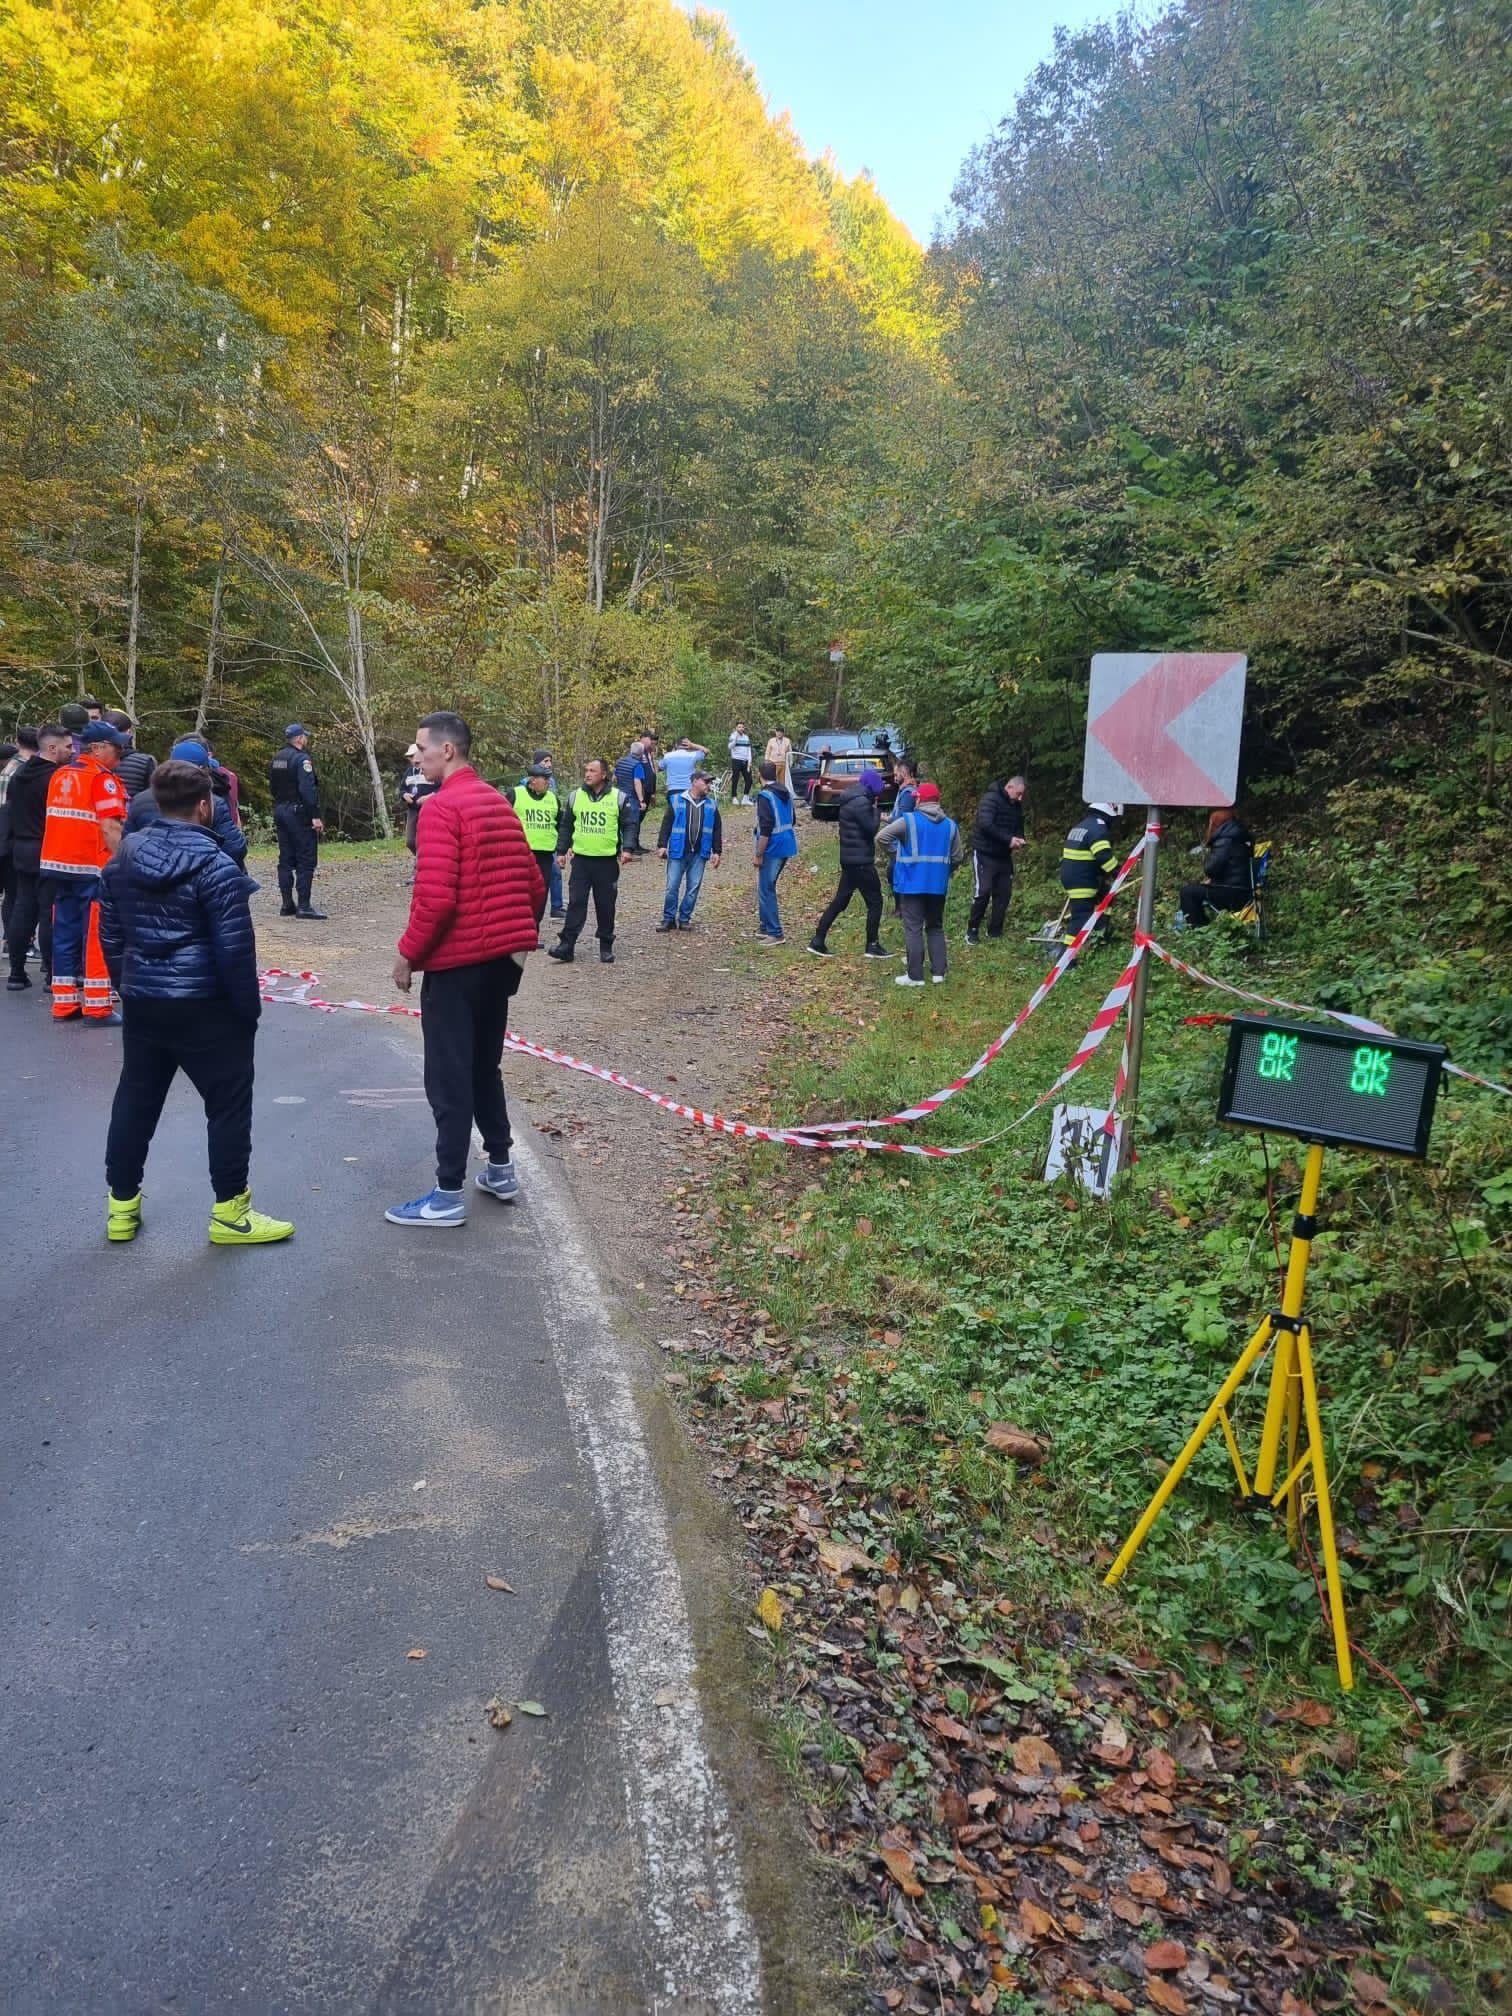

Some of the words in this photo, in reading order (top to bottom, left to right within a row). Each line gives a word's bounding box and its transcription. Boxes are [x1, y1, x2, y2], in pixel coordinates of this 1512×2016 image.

[526, 809, 551, 823] MSS
[581, 812, 606, 827] MSS
[1261, 1032, 1298, 1059] OK
[1258, 1056, 1294, 1081] OK
[1354, 1046, 1392, 1073] OK
[1350, 1069, 1388, 1096] OK
